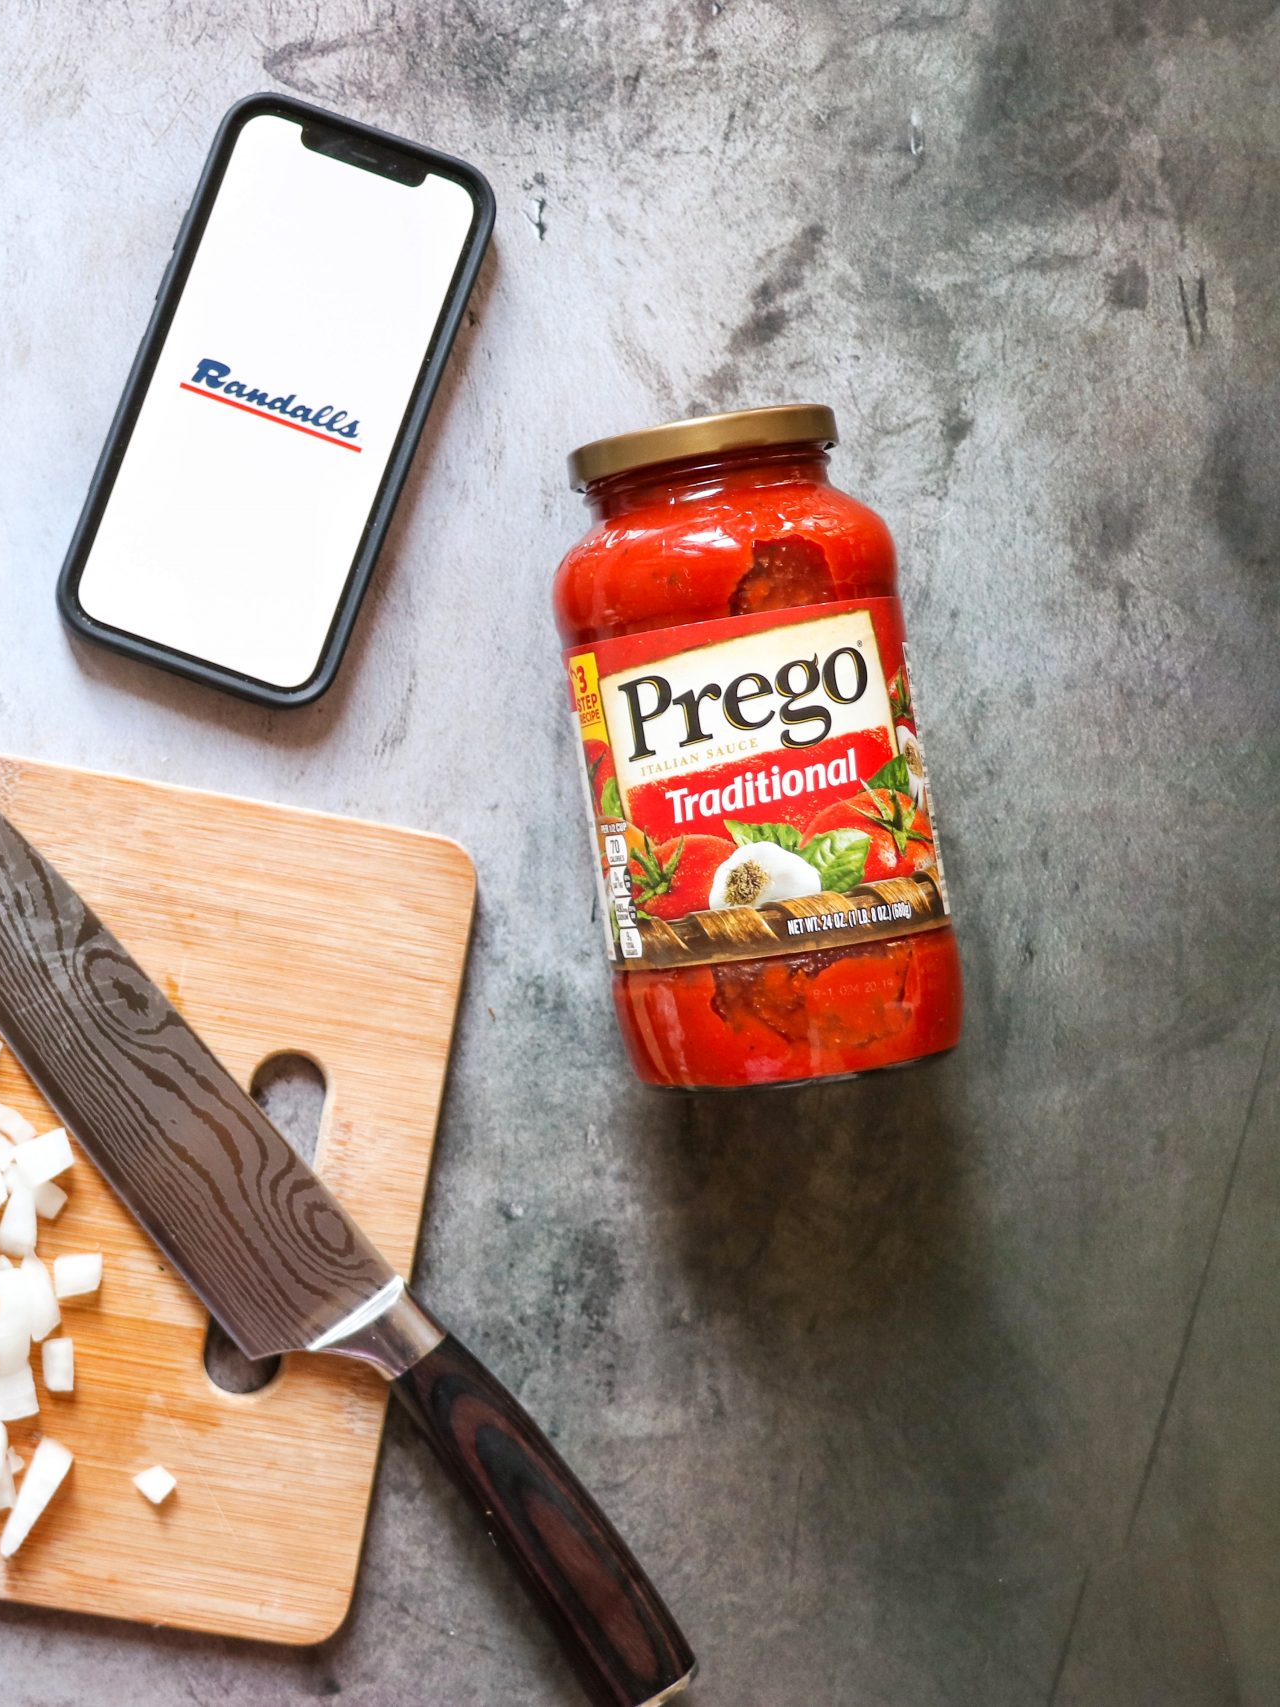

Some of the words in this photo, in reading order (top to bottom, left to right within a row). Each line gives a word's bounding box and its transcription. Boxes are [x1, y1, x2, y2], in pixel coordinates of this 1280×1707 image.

[191, 358, 360, 438] Randalls
[576, 665, 587, 693] 3
[577, 693, 598, 712] STEP
[617, 647, 868, 762] Prego
[641, 753, 699, 776] ITALIAN
[706, 738, 758, 759] SAUCE
[665, 748, 857, 824] Traditional
[610, 839, 620, 854] 70
[787, 918, 804, 936] NET
[804, 916, 821, 933] WT.
[821, 914, 833, 931] 24
[833, 912, 848, 929] OZ.
[848, 909, 856, 928] (1
[857, 908, 871, 925] LB.
[871, 907, 877, 923] 8
[877, 904, 892, 922] OZ.)
[892, 901, 912, 920] (680g)
